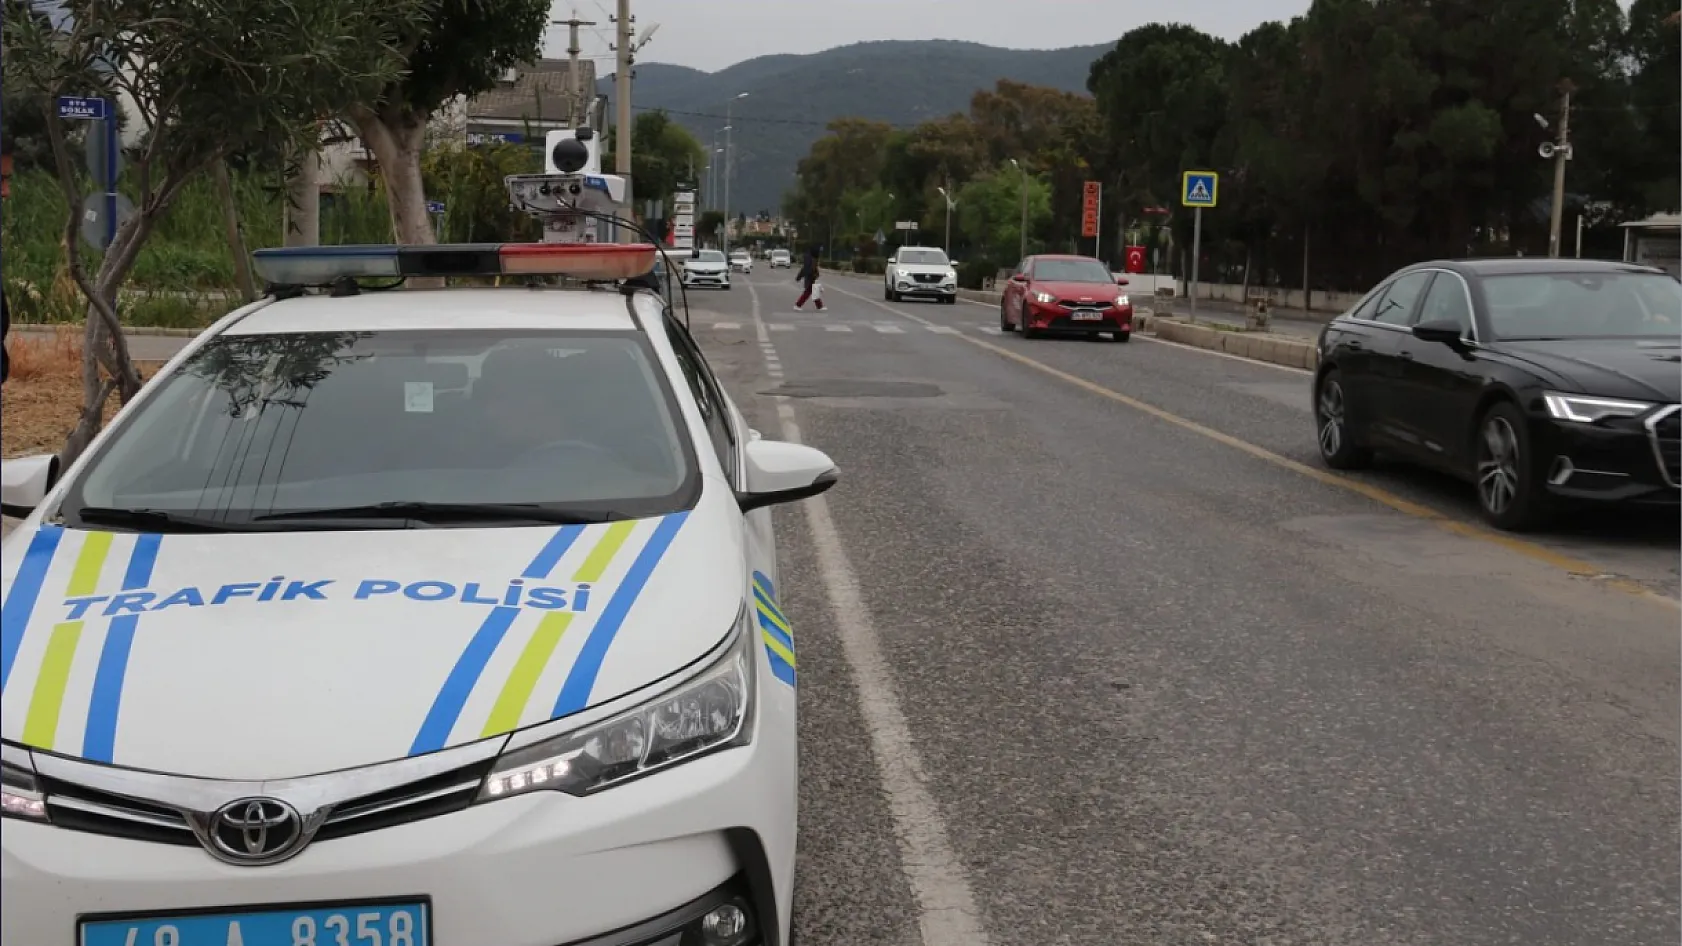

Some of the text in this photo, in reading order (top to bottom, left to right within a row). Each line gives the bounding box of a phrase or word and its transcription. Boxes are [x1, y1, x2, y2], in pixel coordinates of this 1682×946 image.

[63, 575, 592, 620] TRAFİK POLİSİ
[291, 910, 413, 946] 8358
